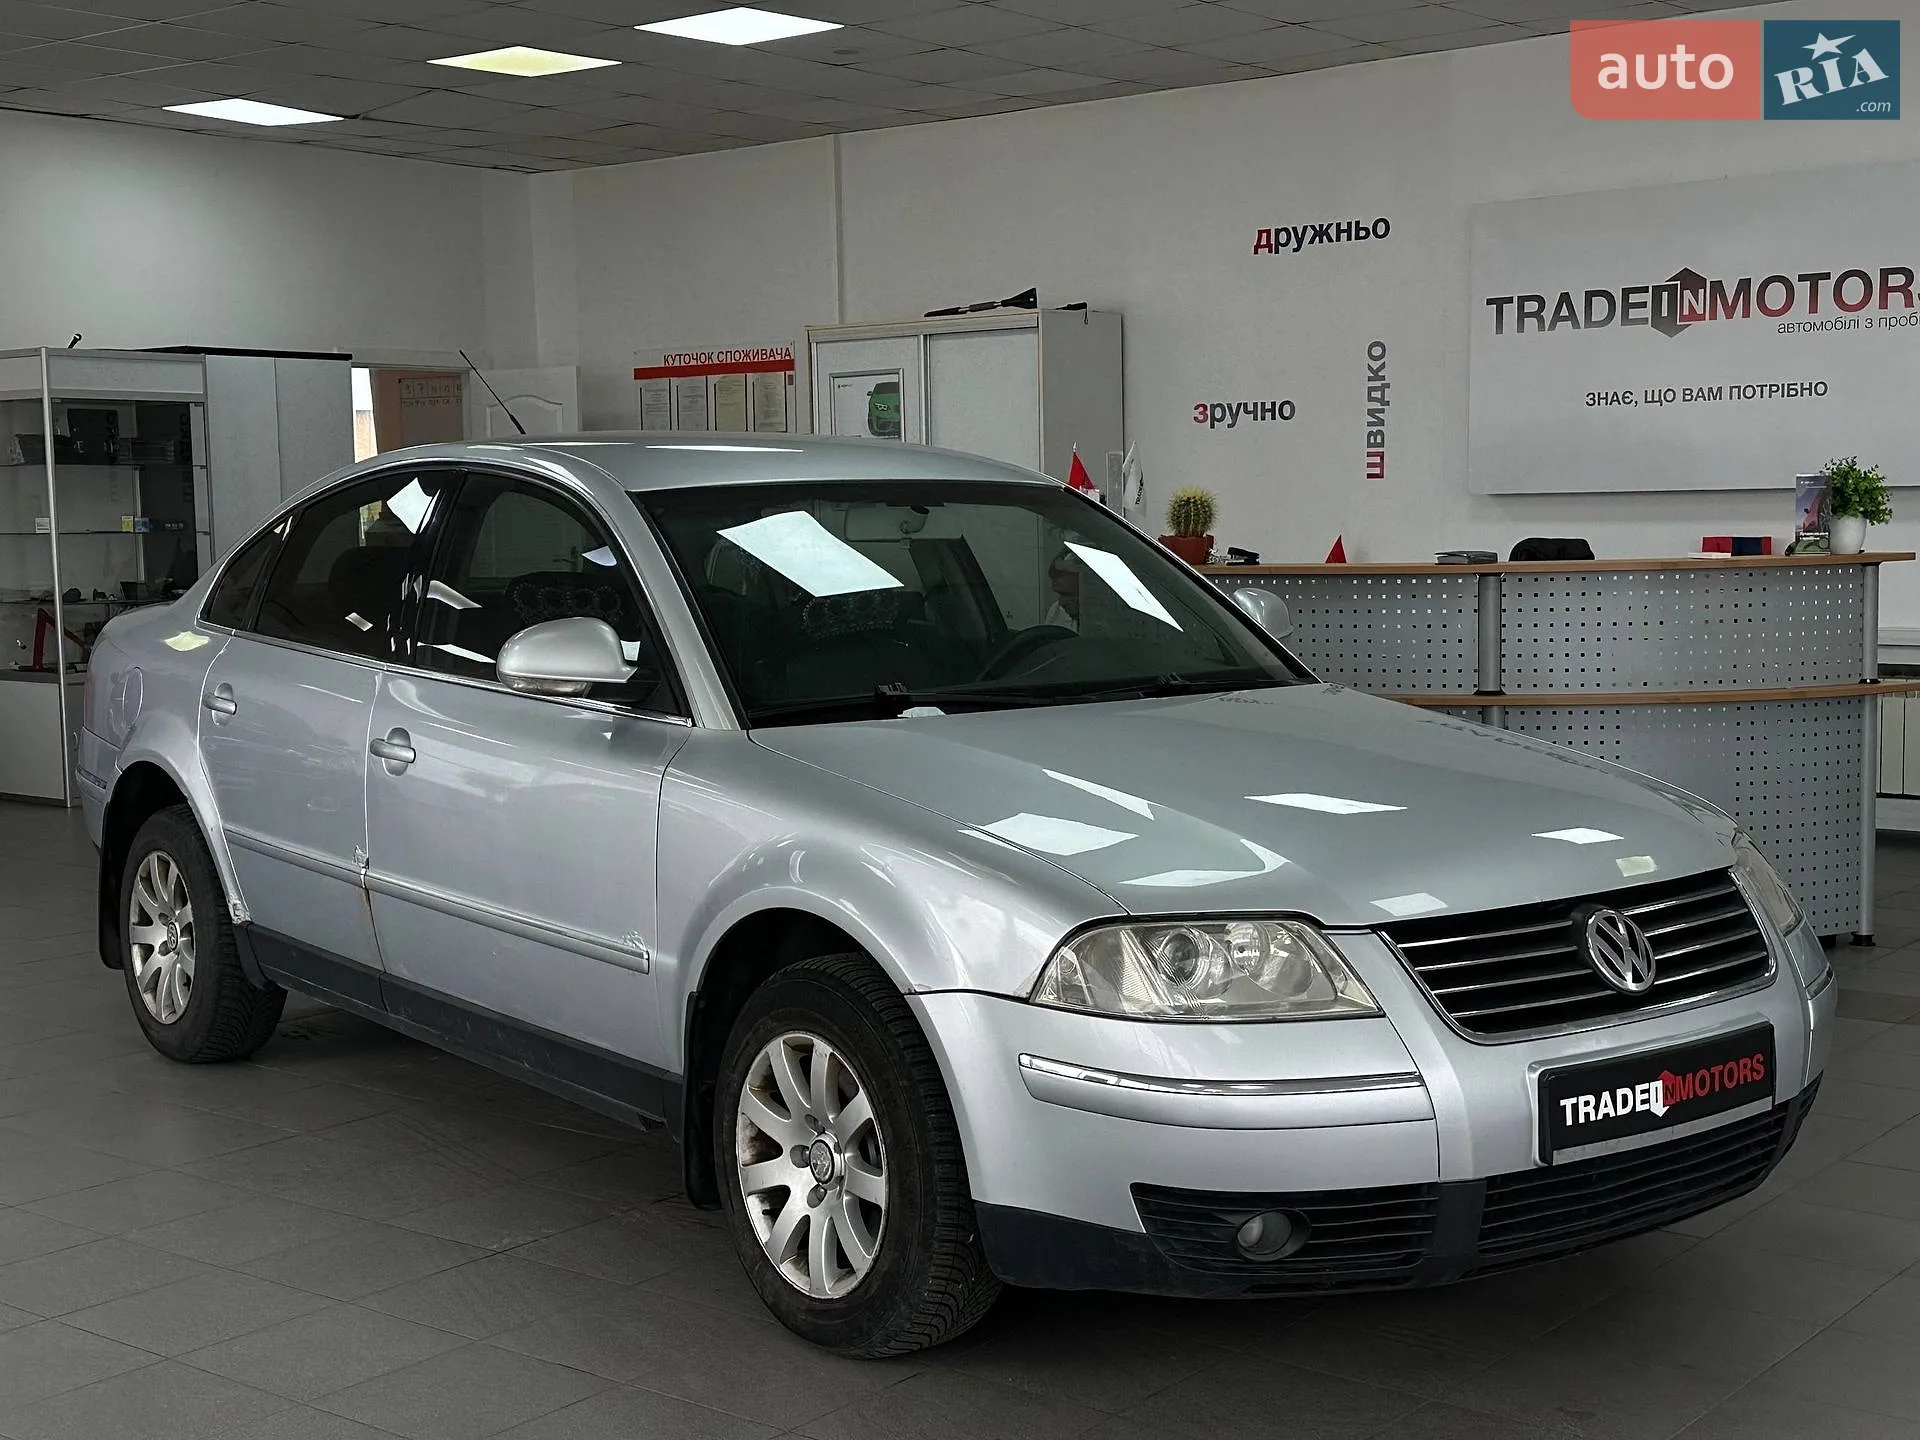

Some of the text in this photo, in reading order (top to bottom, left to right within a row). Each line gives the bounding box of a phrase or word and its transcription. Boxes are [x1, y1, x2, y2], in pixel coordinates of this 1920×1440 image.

[1253, 217, 1391, 255] дружньо
[1777, 312, 1920, 334] автомобілі з проб
[663, 347, 792, 366] КУТОЧОК СПОЖИВАЧА
[1584, 381, 1829, 408] ЗНАЄ, ЩО ВАМ ПОТРІБНО
[1193, 399, 1296, 429] зручно
[1366, 340, 1391, 479] швидко
